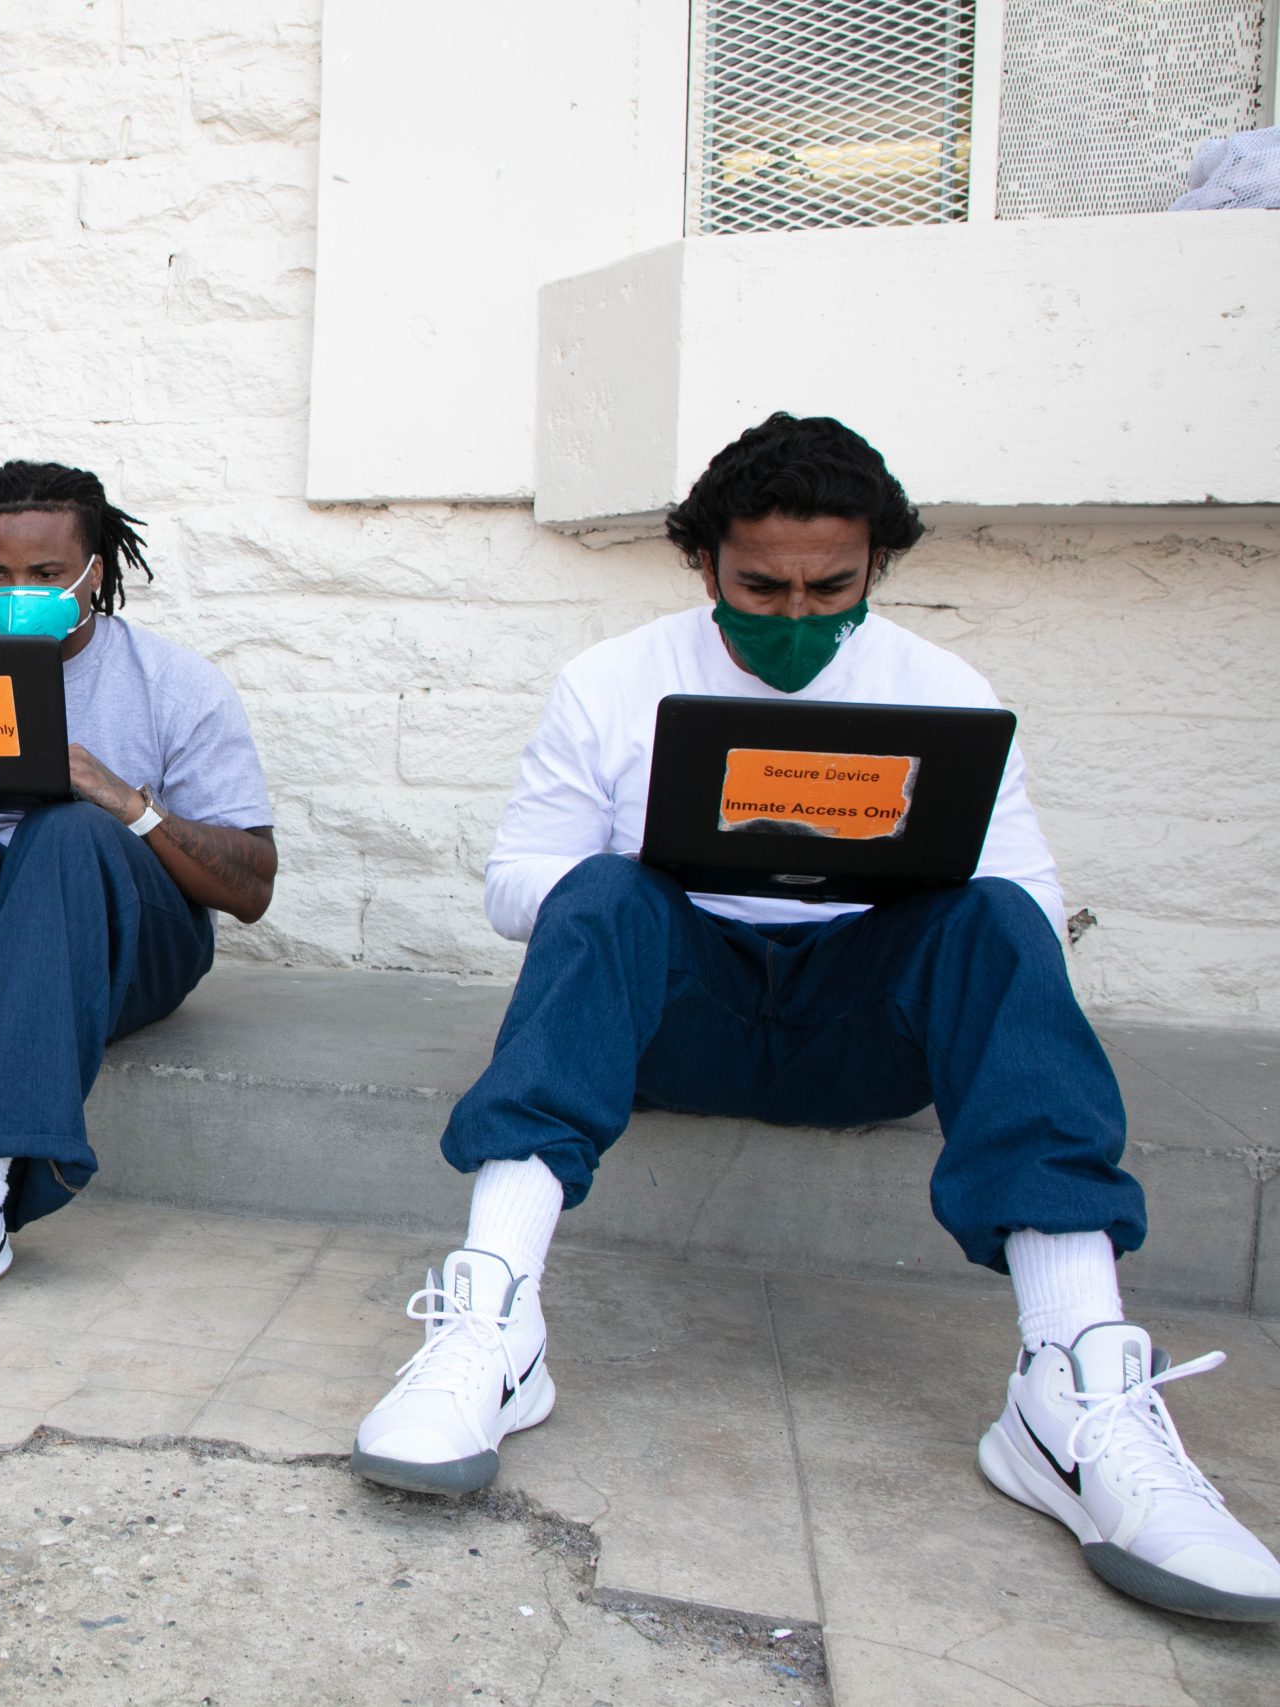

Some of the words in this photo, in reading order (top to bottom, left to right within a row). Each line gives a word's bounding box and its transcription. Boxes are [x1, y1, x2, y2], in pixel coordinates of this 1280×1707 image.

[763, 765, 820, 779] Secure
[825, 768, 880, 782] Device
[725, 799, 786, 813] Inmate
[791, 802, 858, 817] Access
